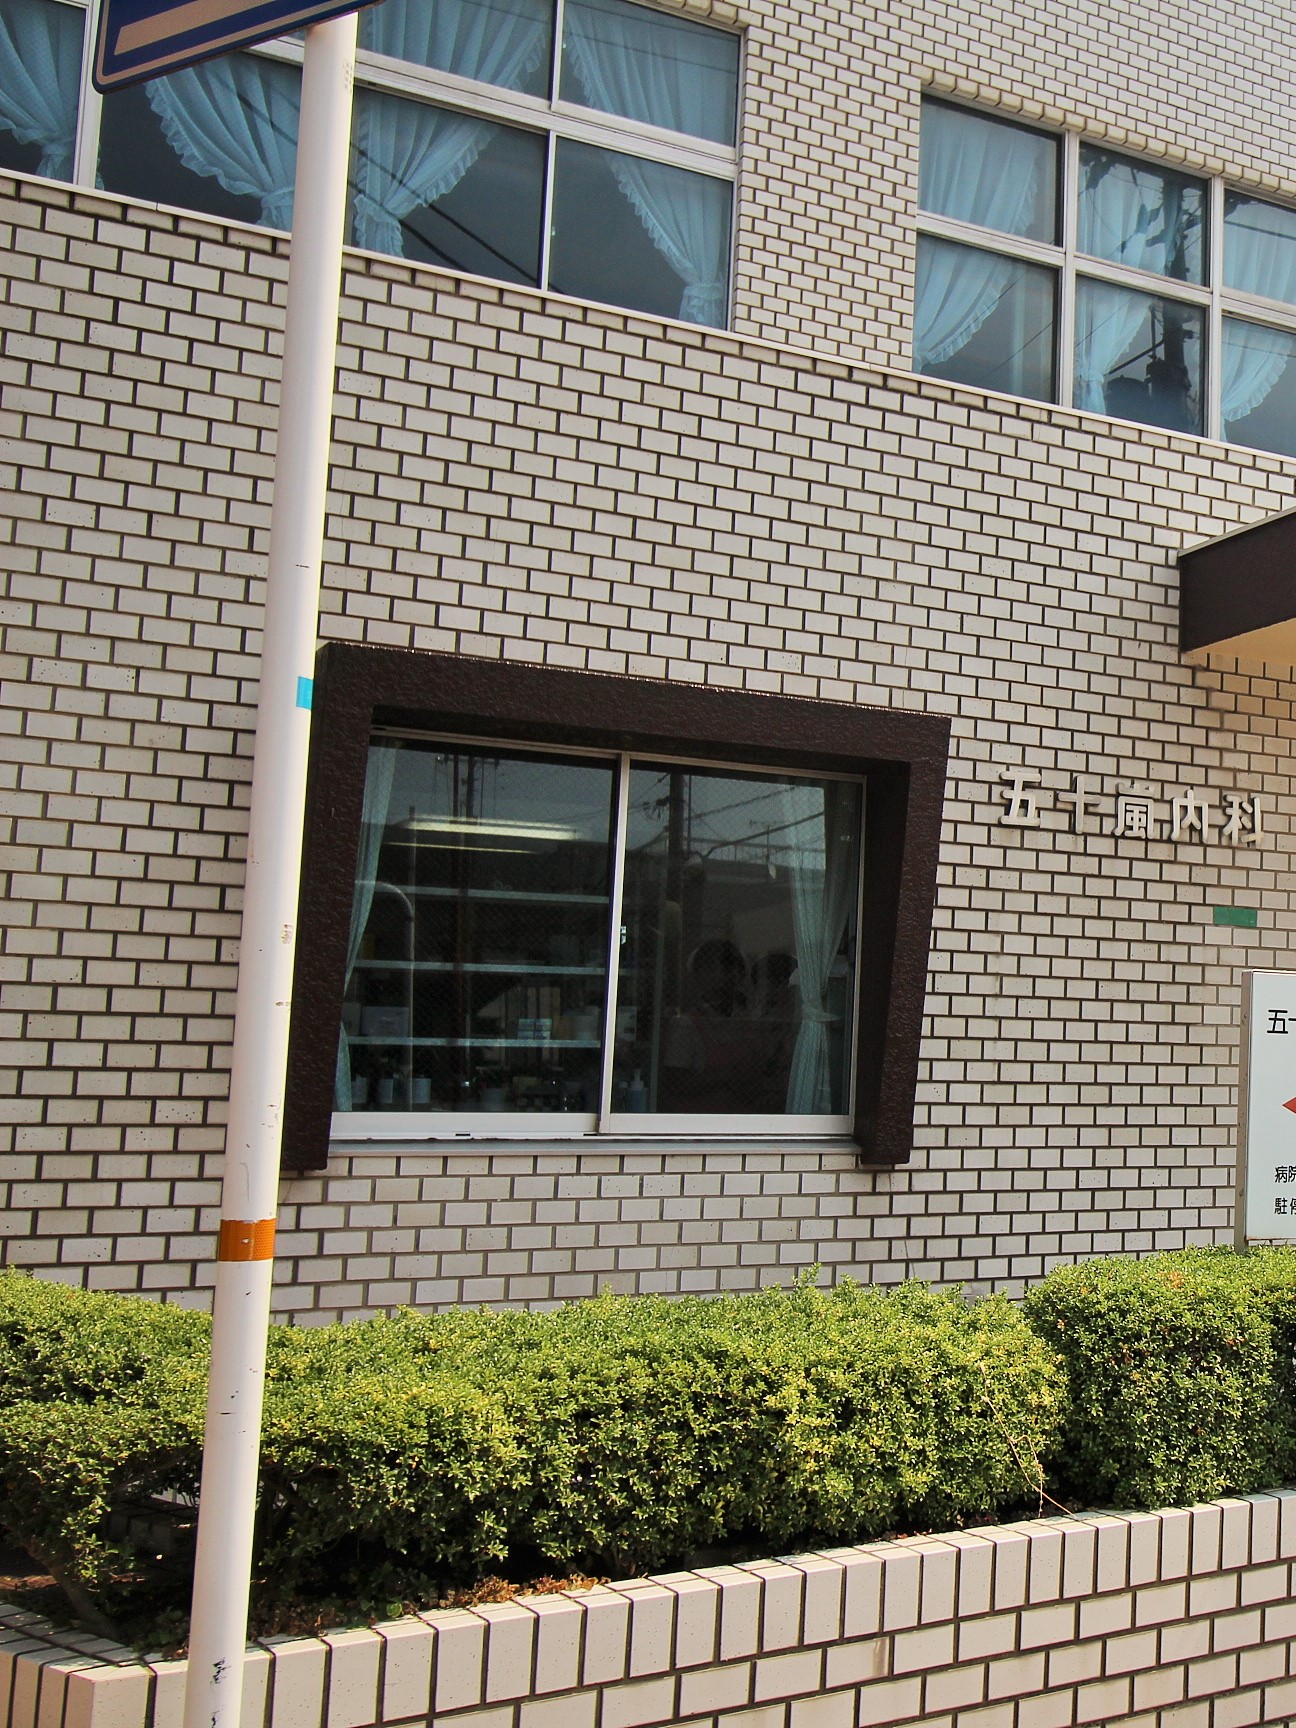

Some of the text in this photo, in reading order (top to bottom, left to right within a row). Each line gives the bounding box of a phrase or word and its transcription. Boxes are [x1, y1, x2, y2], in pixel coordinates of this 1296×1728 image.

[999, 771, 1264, 848] 五十嵐内科
